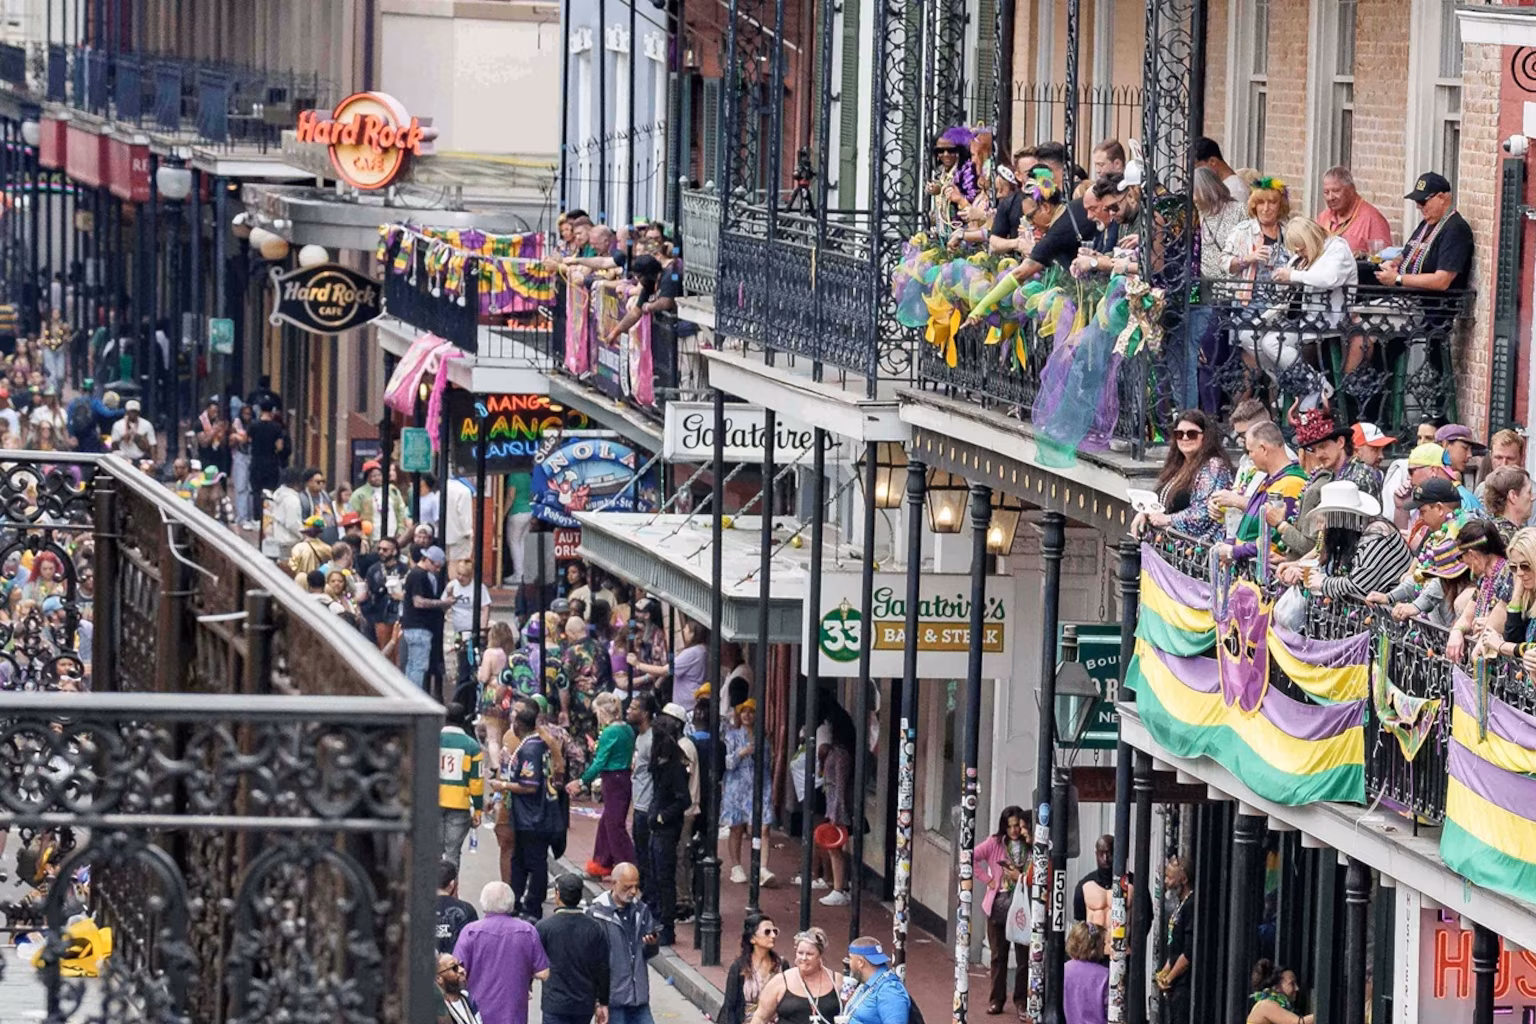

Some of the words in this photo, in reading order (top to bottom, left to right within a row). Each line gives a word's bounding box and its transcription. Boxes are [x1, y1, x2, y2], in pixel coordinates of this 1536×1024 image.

[297, 109, 361, 146] Hard
[361, 113, 425, 156] Rock
[284, 280, 332, 301] Hard
[332, 282, 377, 307] Rock
[318, 305, 343, 317] CAFE
[551, 441, 636, 475] NOLA
[823, 619, 861, 651] 33
[924, 628, 938, 643] &
[941, 630, 998, 644] STEK
